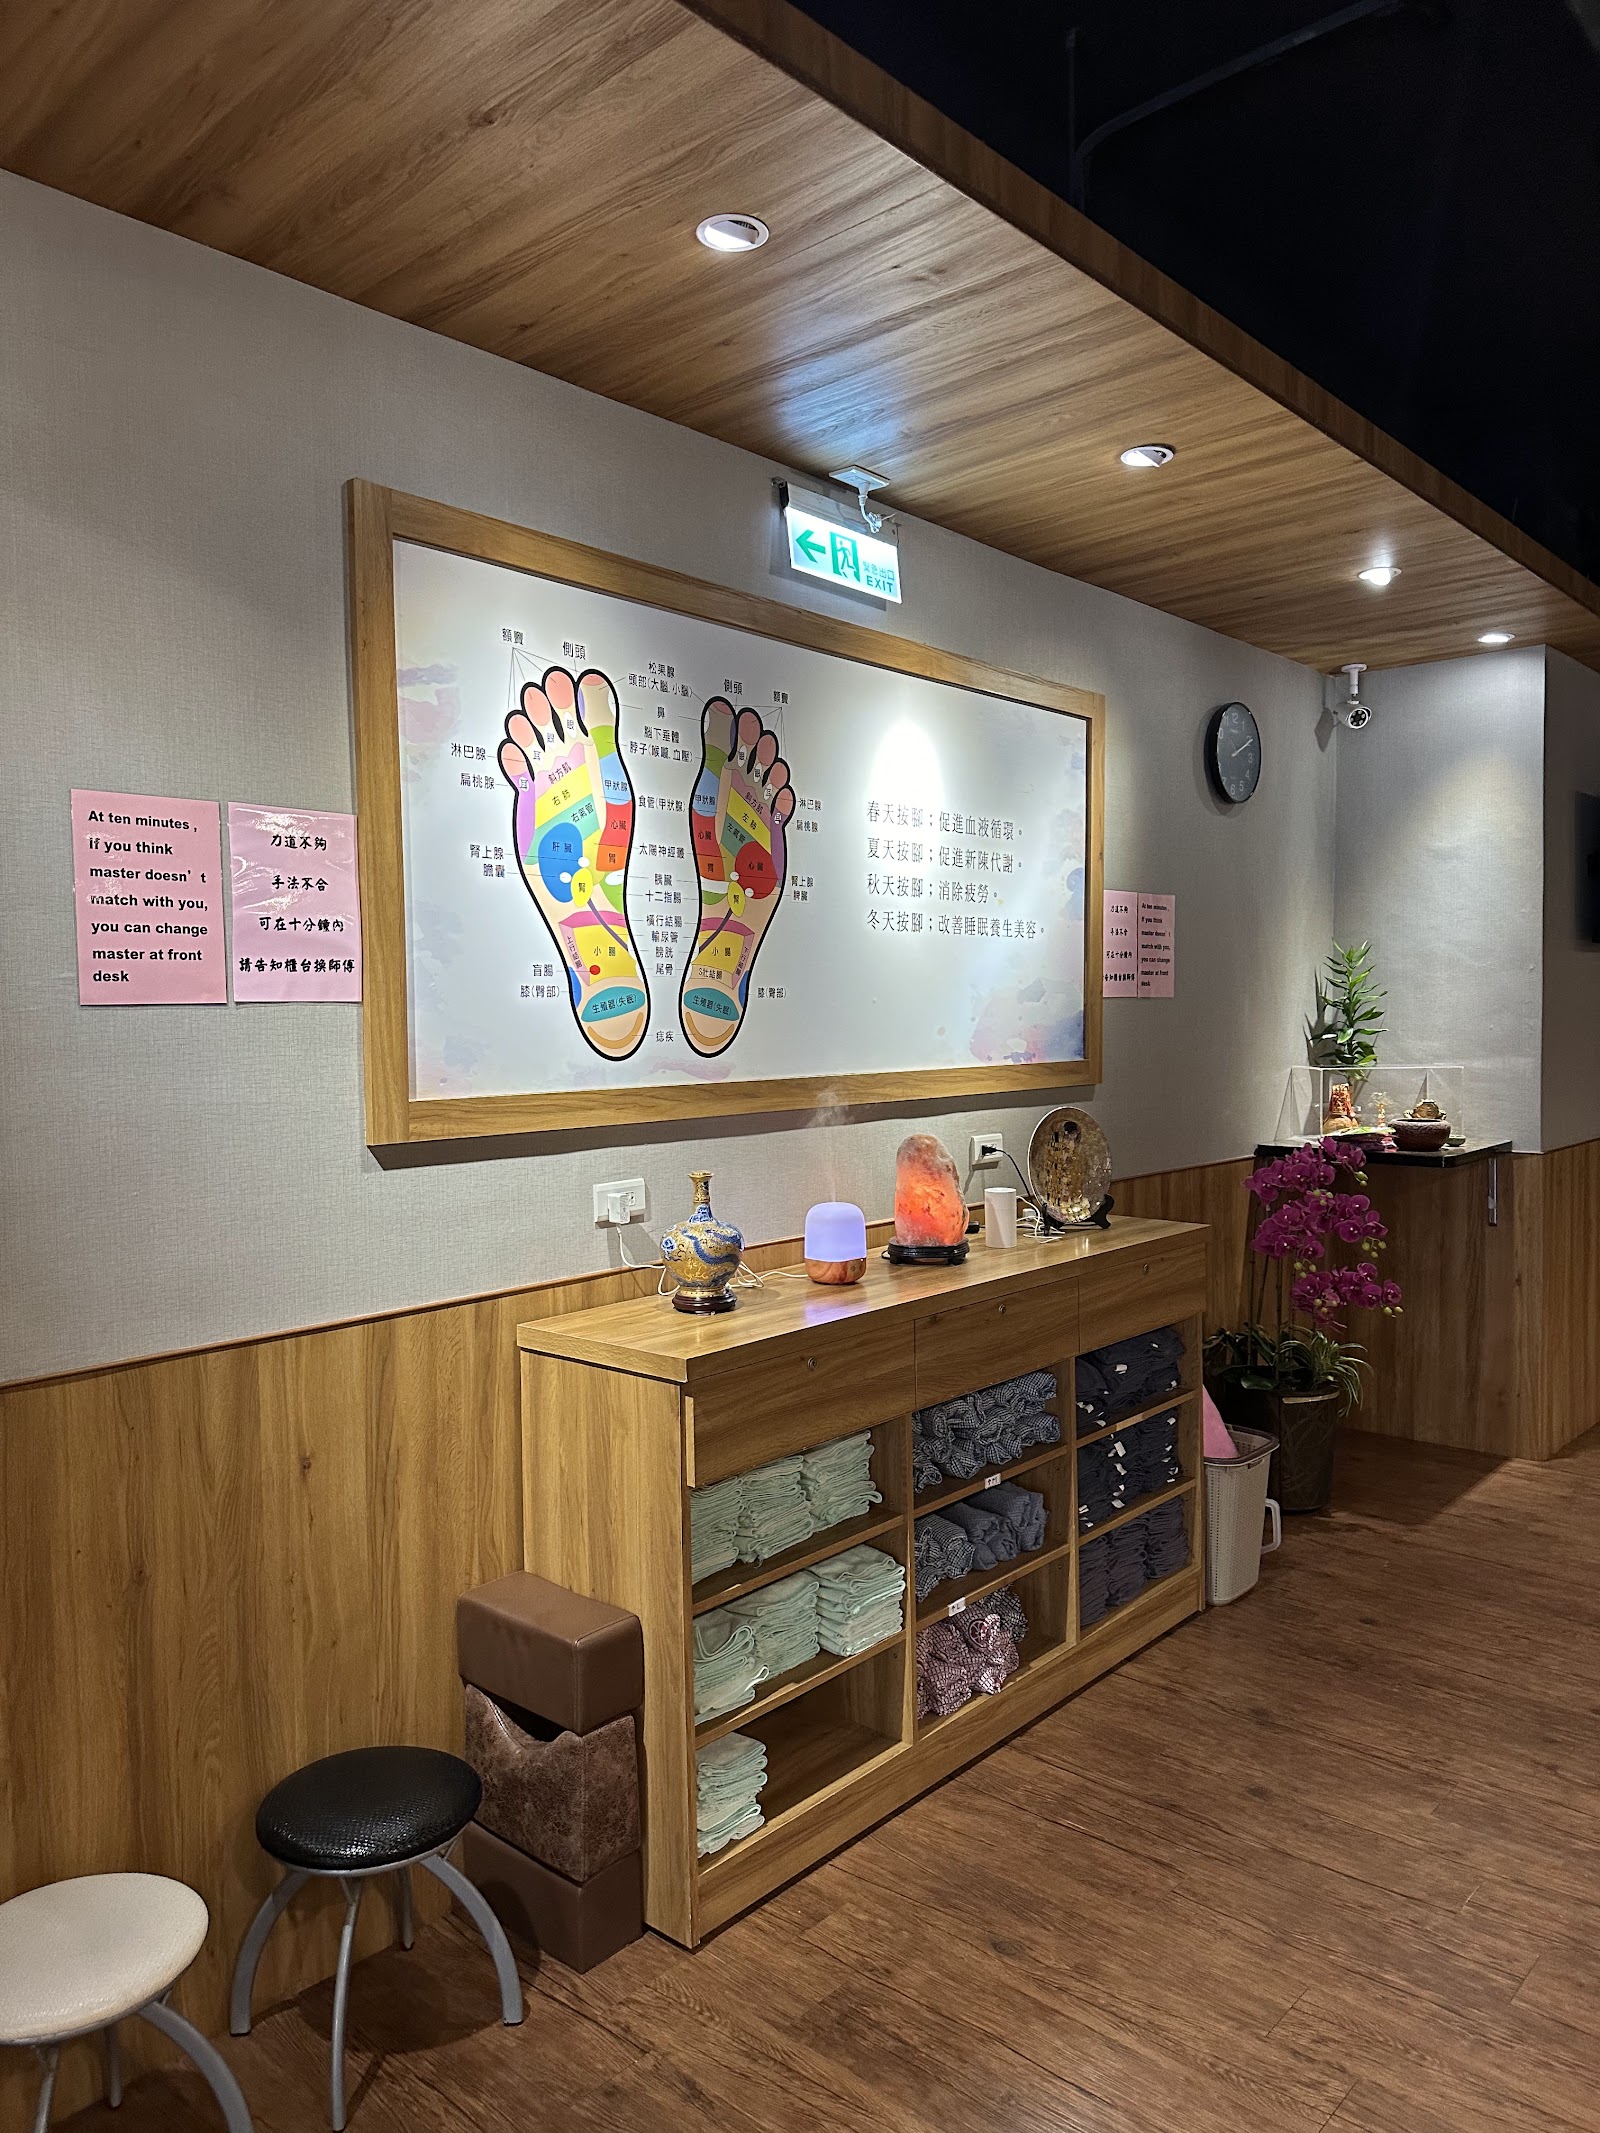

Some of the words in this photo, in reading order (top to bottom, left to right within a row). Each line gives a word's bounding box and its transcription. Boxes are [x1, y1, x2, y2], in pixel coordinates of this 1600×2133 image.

[866, 575, 893, 593] EXIT
[562, 641, 586, 660] 側頭
[724, 678, 743, 696] 側頭
[657, 707, 666, 719] 鼻
[1231, 712, 1239, 724] 12
[451, 743, 486, 760] 淋巴腺
[1247, 753, 1253, 763] 3
[460, 772, 495, 790] 扁桃腺
[1245, 769, 1250, 780] 4
[604, 779, 628, 792] 甲狀腺
[1230, 784, 1236, 795] 6
[1239, 781, 1244, 792] 5
[88, 810, 104, 822] At
[108, 813, 131, 825] ten
[104, 842, 131, 853] you
[136, 842, 173, 855] think
[270, 834, 327, 851] 力道不夠
[552, 841, 573, 854] 肝臟
[469, 844, 504, 860] 腎上腺
[90, 867, 141, 880] master
[271, 874, 329, 892] 手法不合
[90, 894, 138, 906] match
[142, 896, 174, 907] with
[178, 899, 208, 911] you,
[645, 889, 682, 904] 十二指腸
[91, 923, 119, 934] you
[124, 924, 150, 933] can
[155, 922, 208, 937] change
[259, 916, 344, 932] 可在十分鐘內
[92, 949, 145, 960] master
[149, 949, 164, 960] at
[168, 949, 202, 960] front
[593, 946, 616, 957] 小腸
[712, 947, 731, 957] 小腸
[239, 957, 355, 973] 請告知櫃台換師傅
[532, 964, 553, 977] 盲腸
[655, 963, 673, 976] 尾骨
[92, 970, 129, 981] desk
